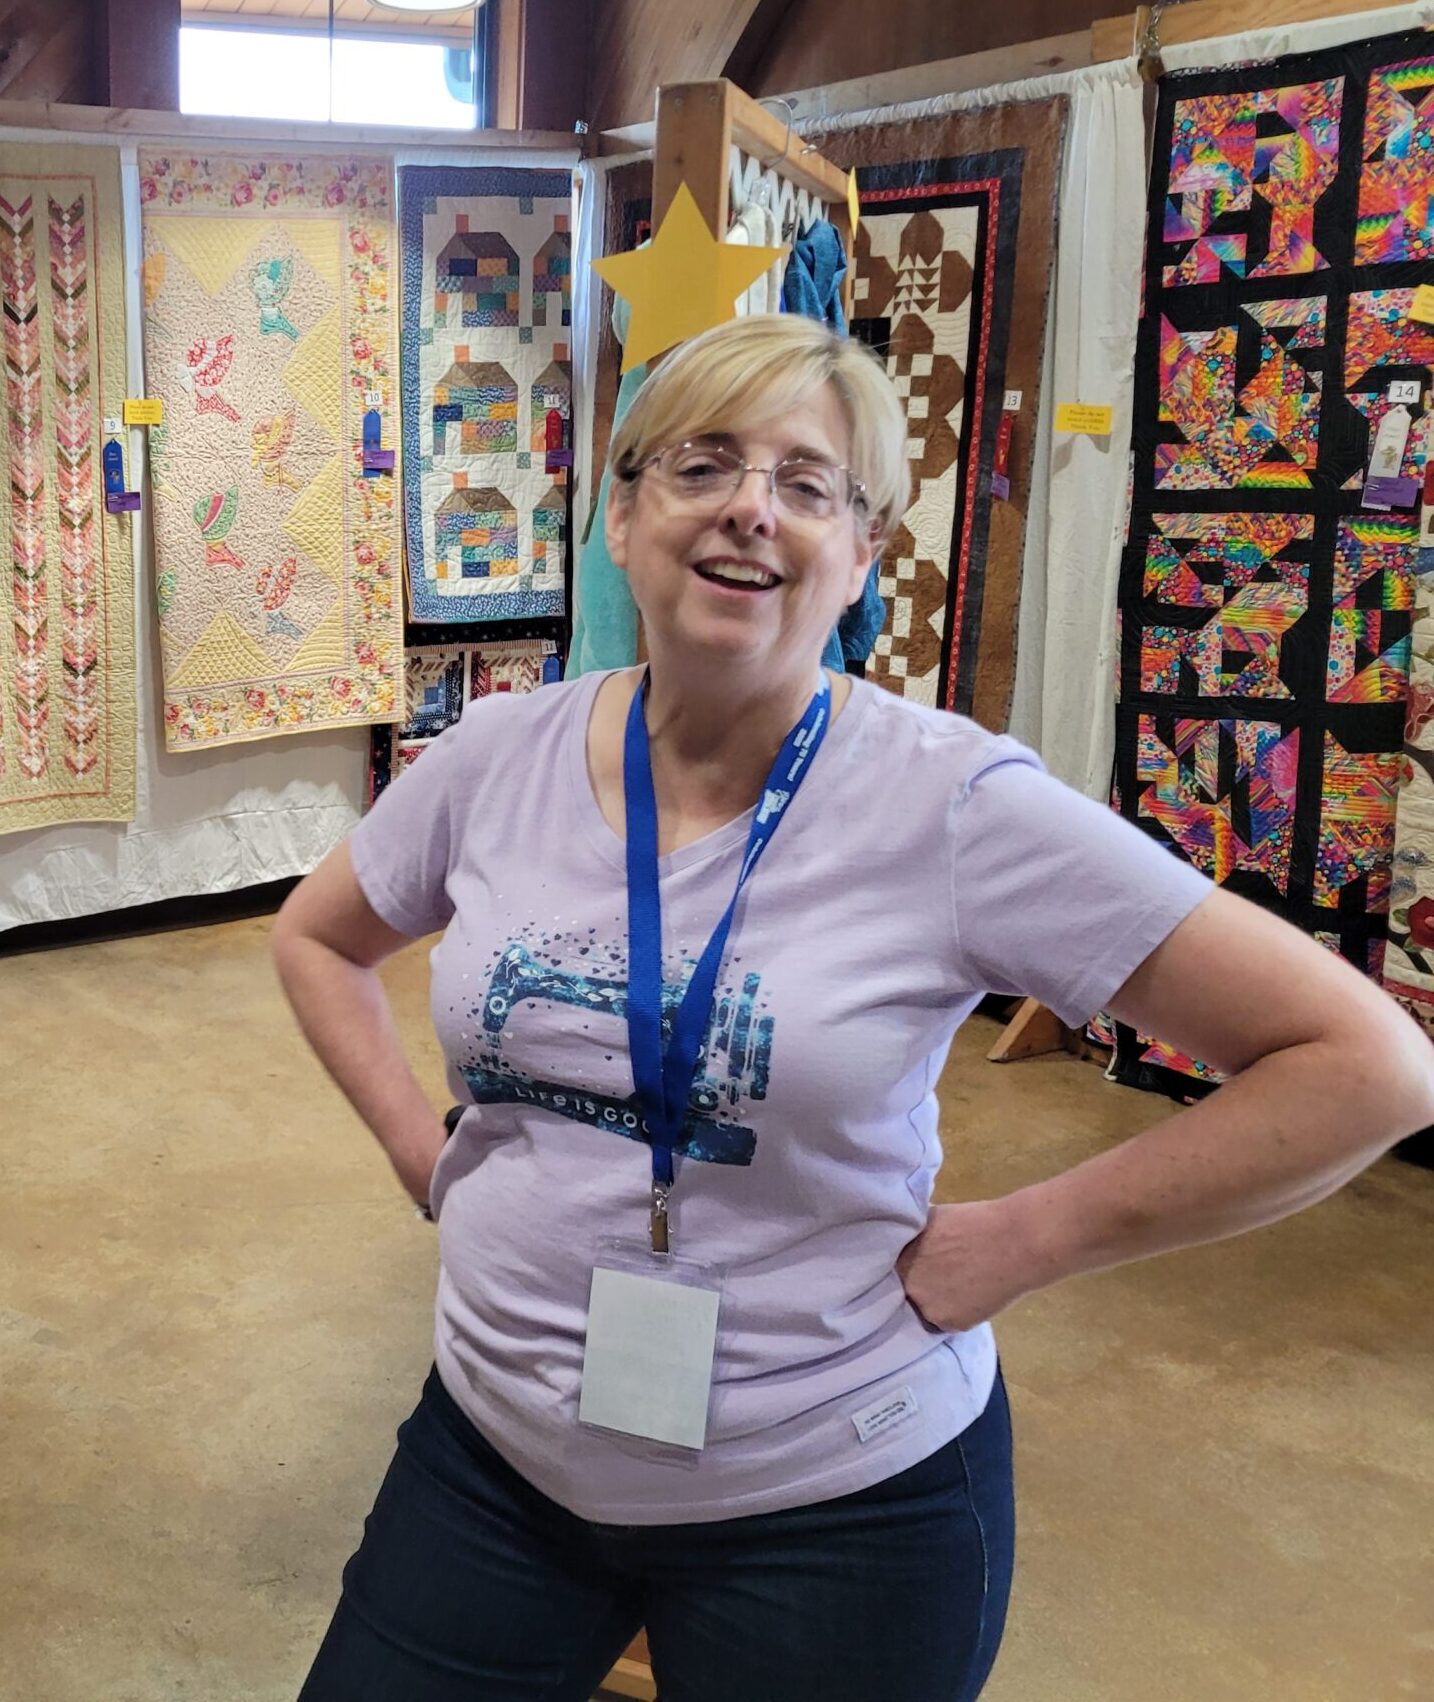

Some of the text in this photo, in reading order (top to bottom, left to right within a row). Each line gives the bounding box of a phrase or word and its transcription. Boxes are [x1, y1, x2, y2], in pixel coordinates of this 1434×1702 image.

[370, 393, 380, 402] 10
[1396, 386, 1415, 398] 14
[110, 421, 116, 431] 9
[574, 1098, 597, 1114] IS
